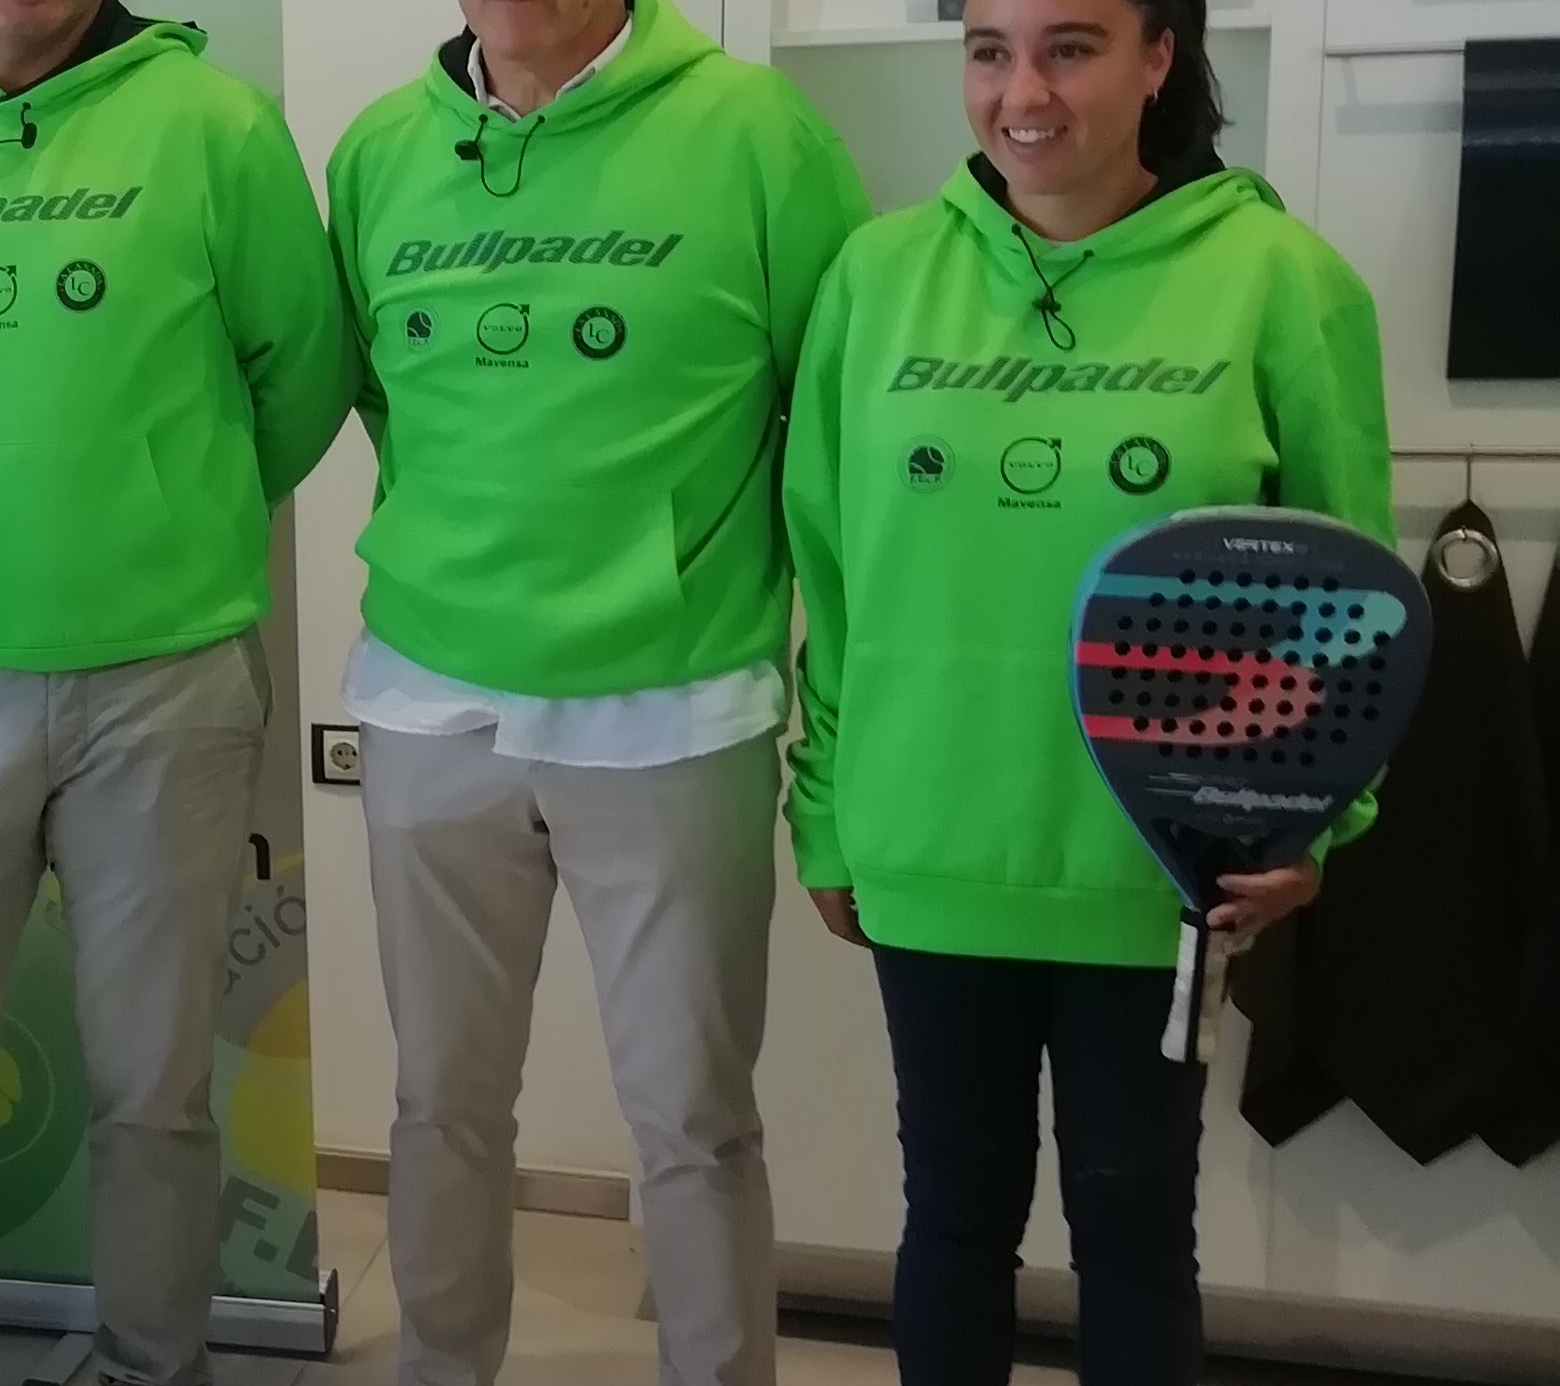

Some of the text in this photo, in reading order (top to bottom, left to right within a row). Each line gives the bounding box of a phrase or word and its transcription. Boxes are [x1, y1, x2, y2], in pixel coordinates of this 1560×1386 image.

[384, 230, 685, 277] Bullpadel
[475, 356, 529, 369] Mavensa
[885, 356, 1231, 403] Bullpadel
[997, 496, 1062, 510] Mavensa
